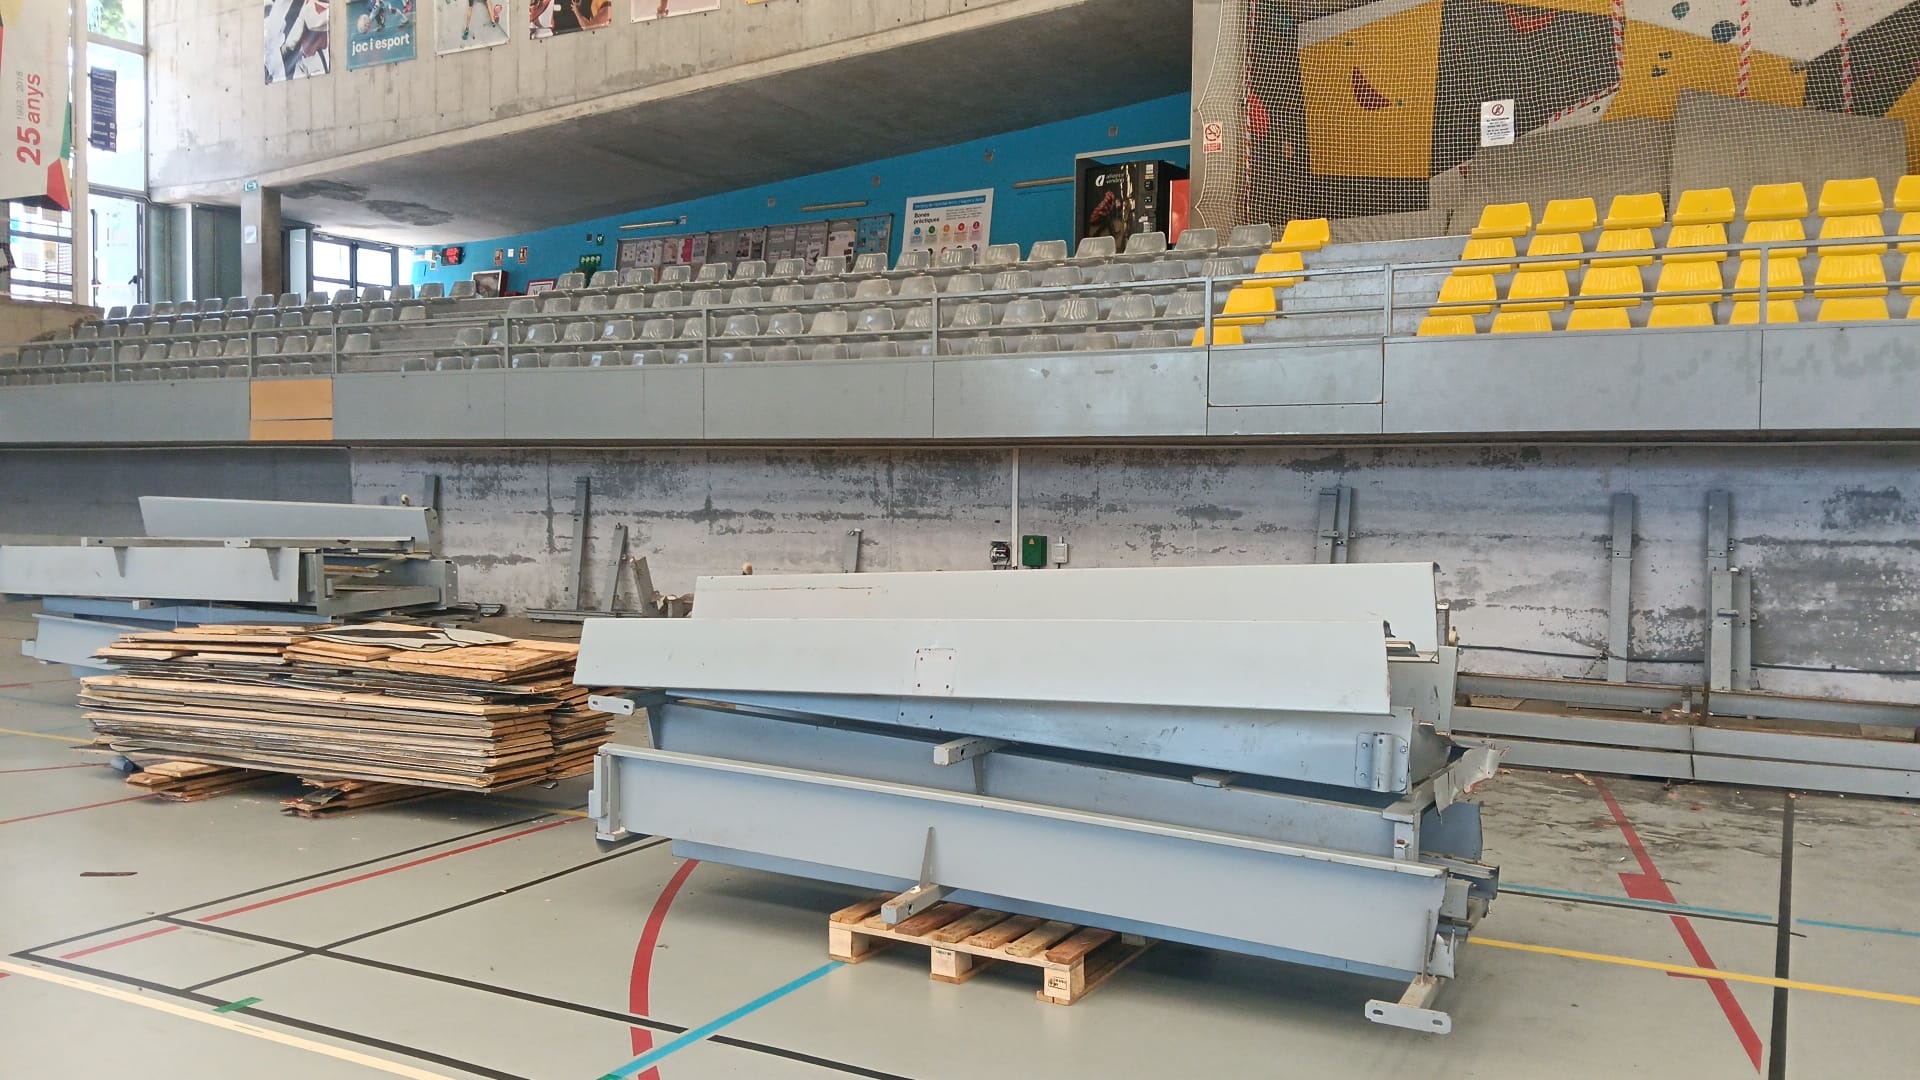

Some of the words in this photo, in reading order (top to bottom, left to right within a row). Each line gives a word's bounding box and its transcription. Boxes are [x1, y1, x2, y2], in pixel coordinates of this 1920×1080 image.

[352, 40, 369, 56] joc
[369, 38, 374, 51] i
[375, 33, 410, 50] esport
[27, 73, 44, 124] anys
[16, 126, 41, 166] 25
